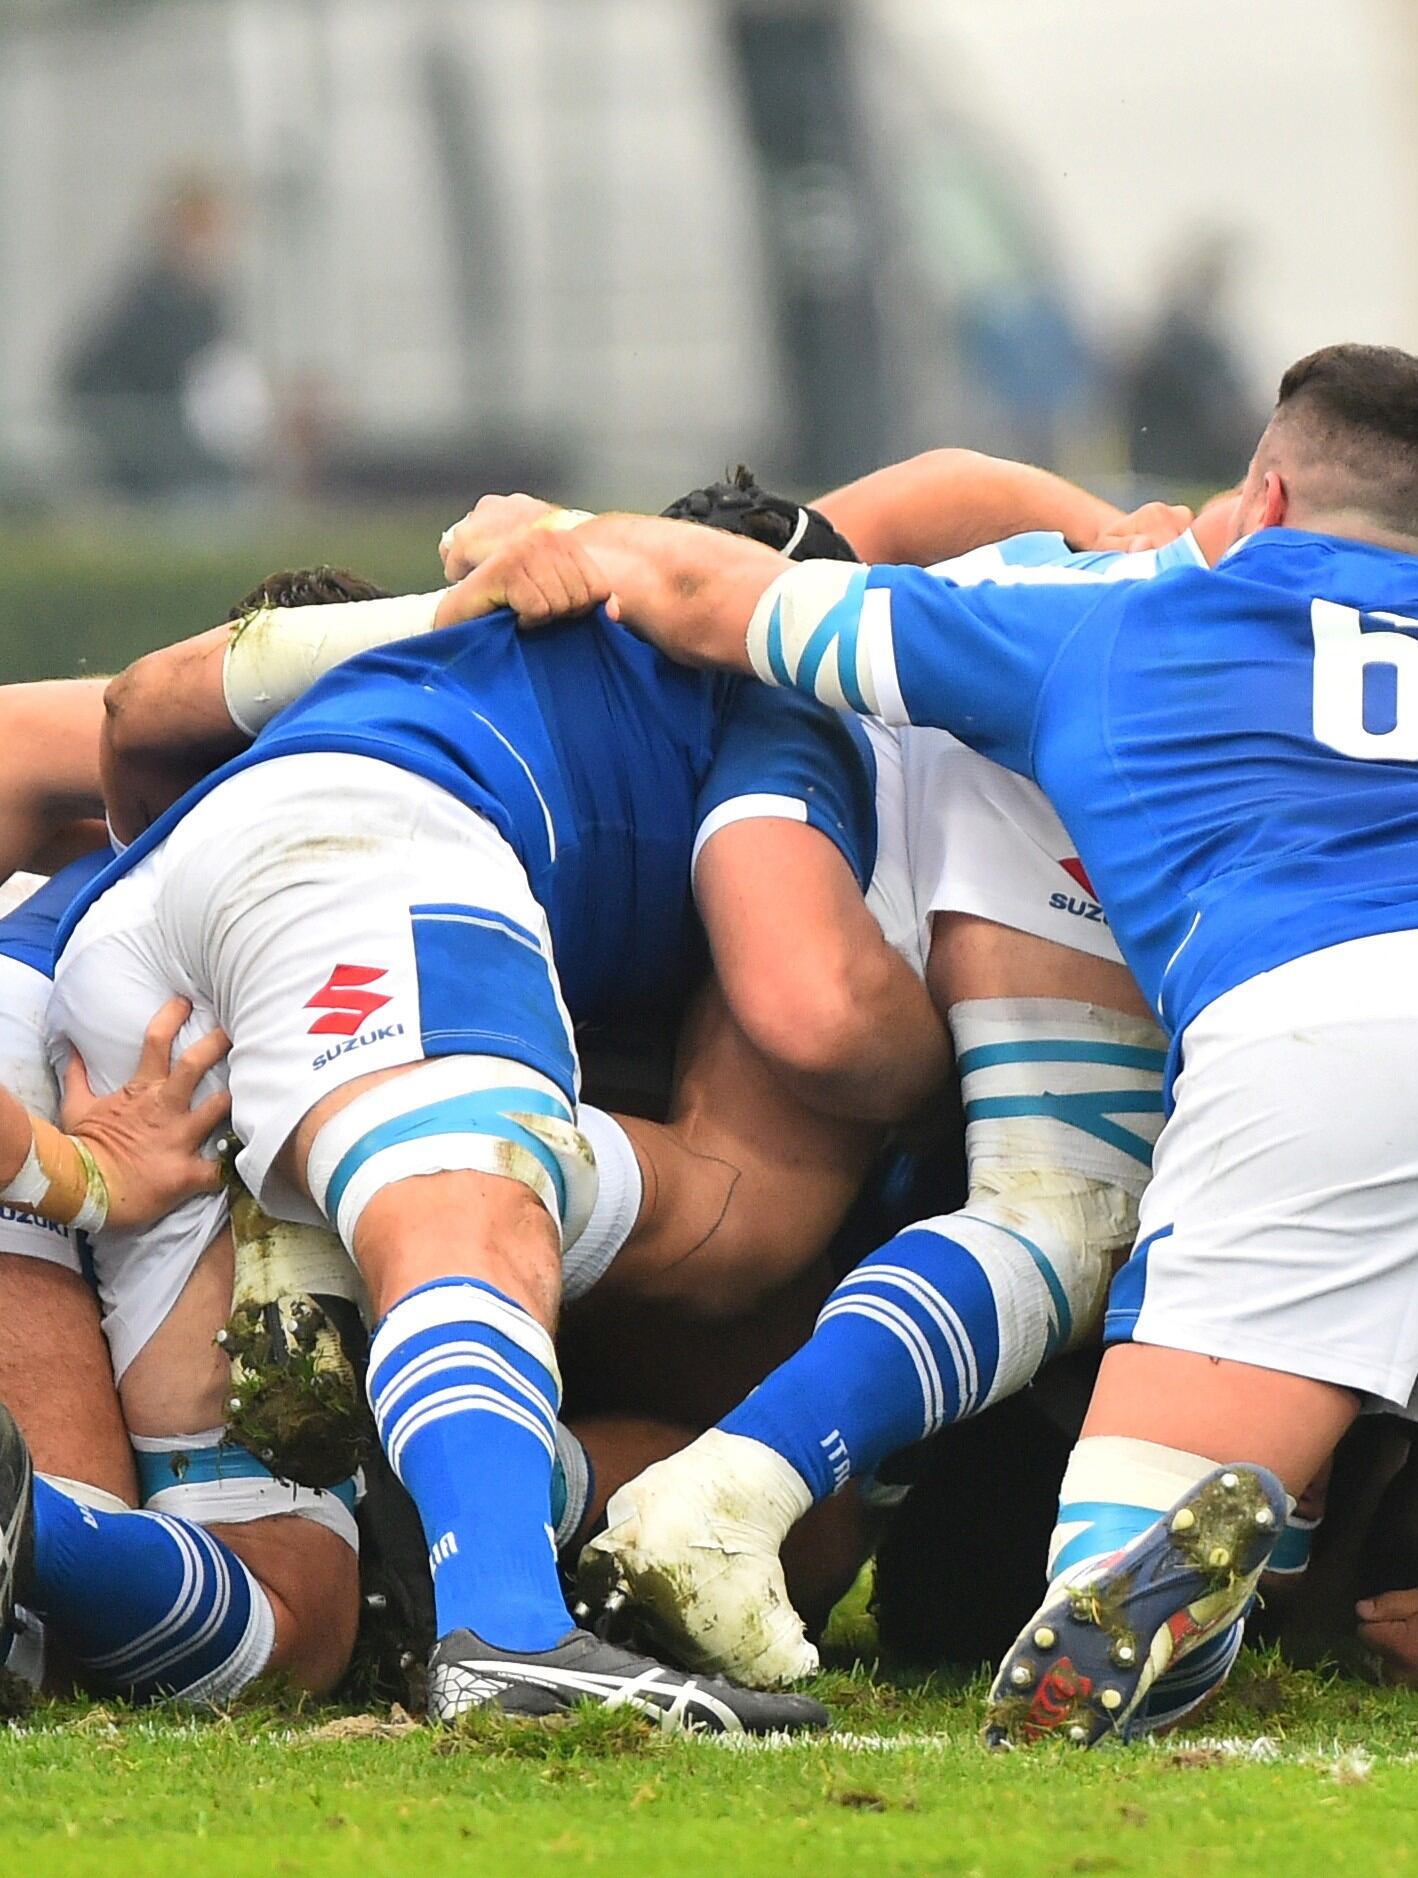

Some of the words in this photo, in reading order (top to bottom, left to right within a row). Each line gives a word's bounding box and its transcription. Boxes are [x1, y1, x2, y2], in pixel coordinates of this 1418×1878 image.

[1049, 892, 1109, 926] SUZ
[312, 1023, 404, 1071] SUZUKI
[0, 1206, 69, 1238] UZUKI
